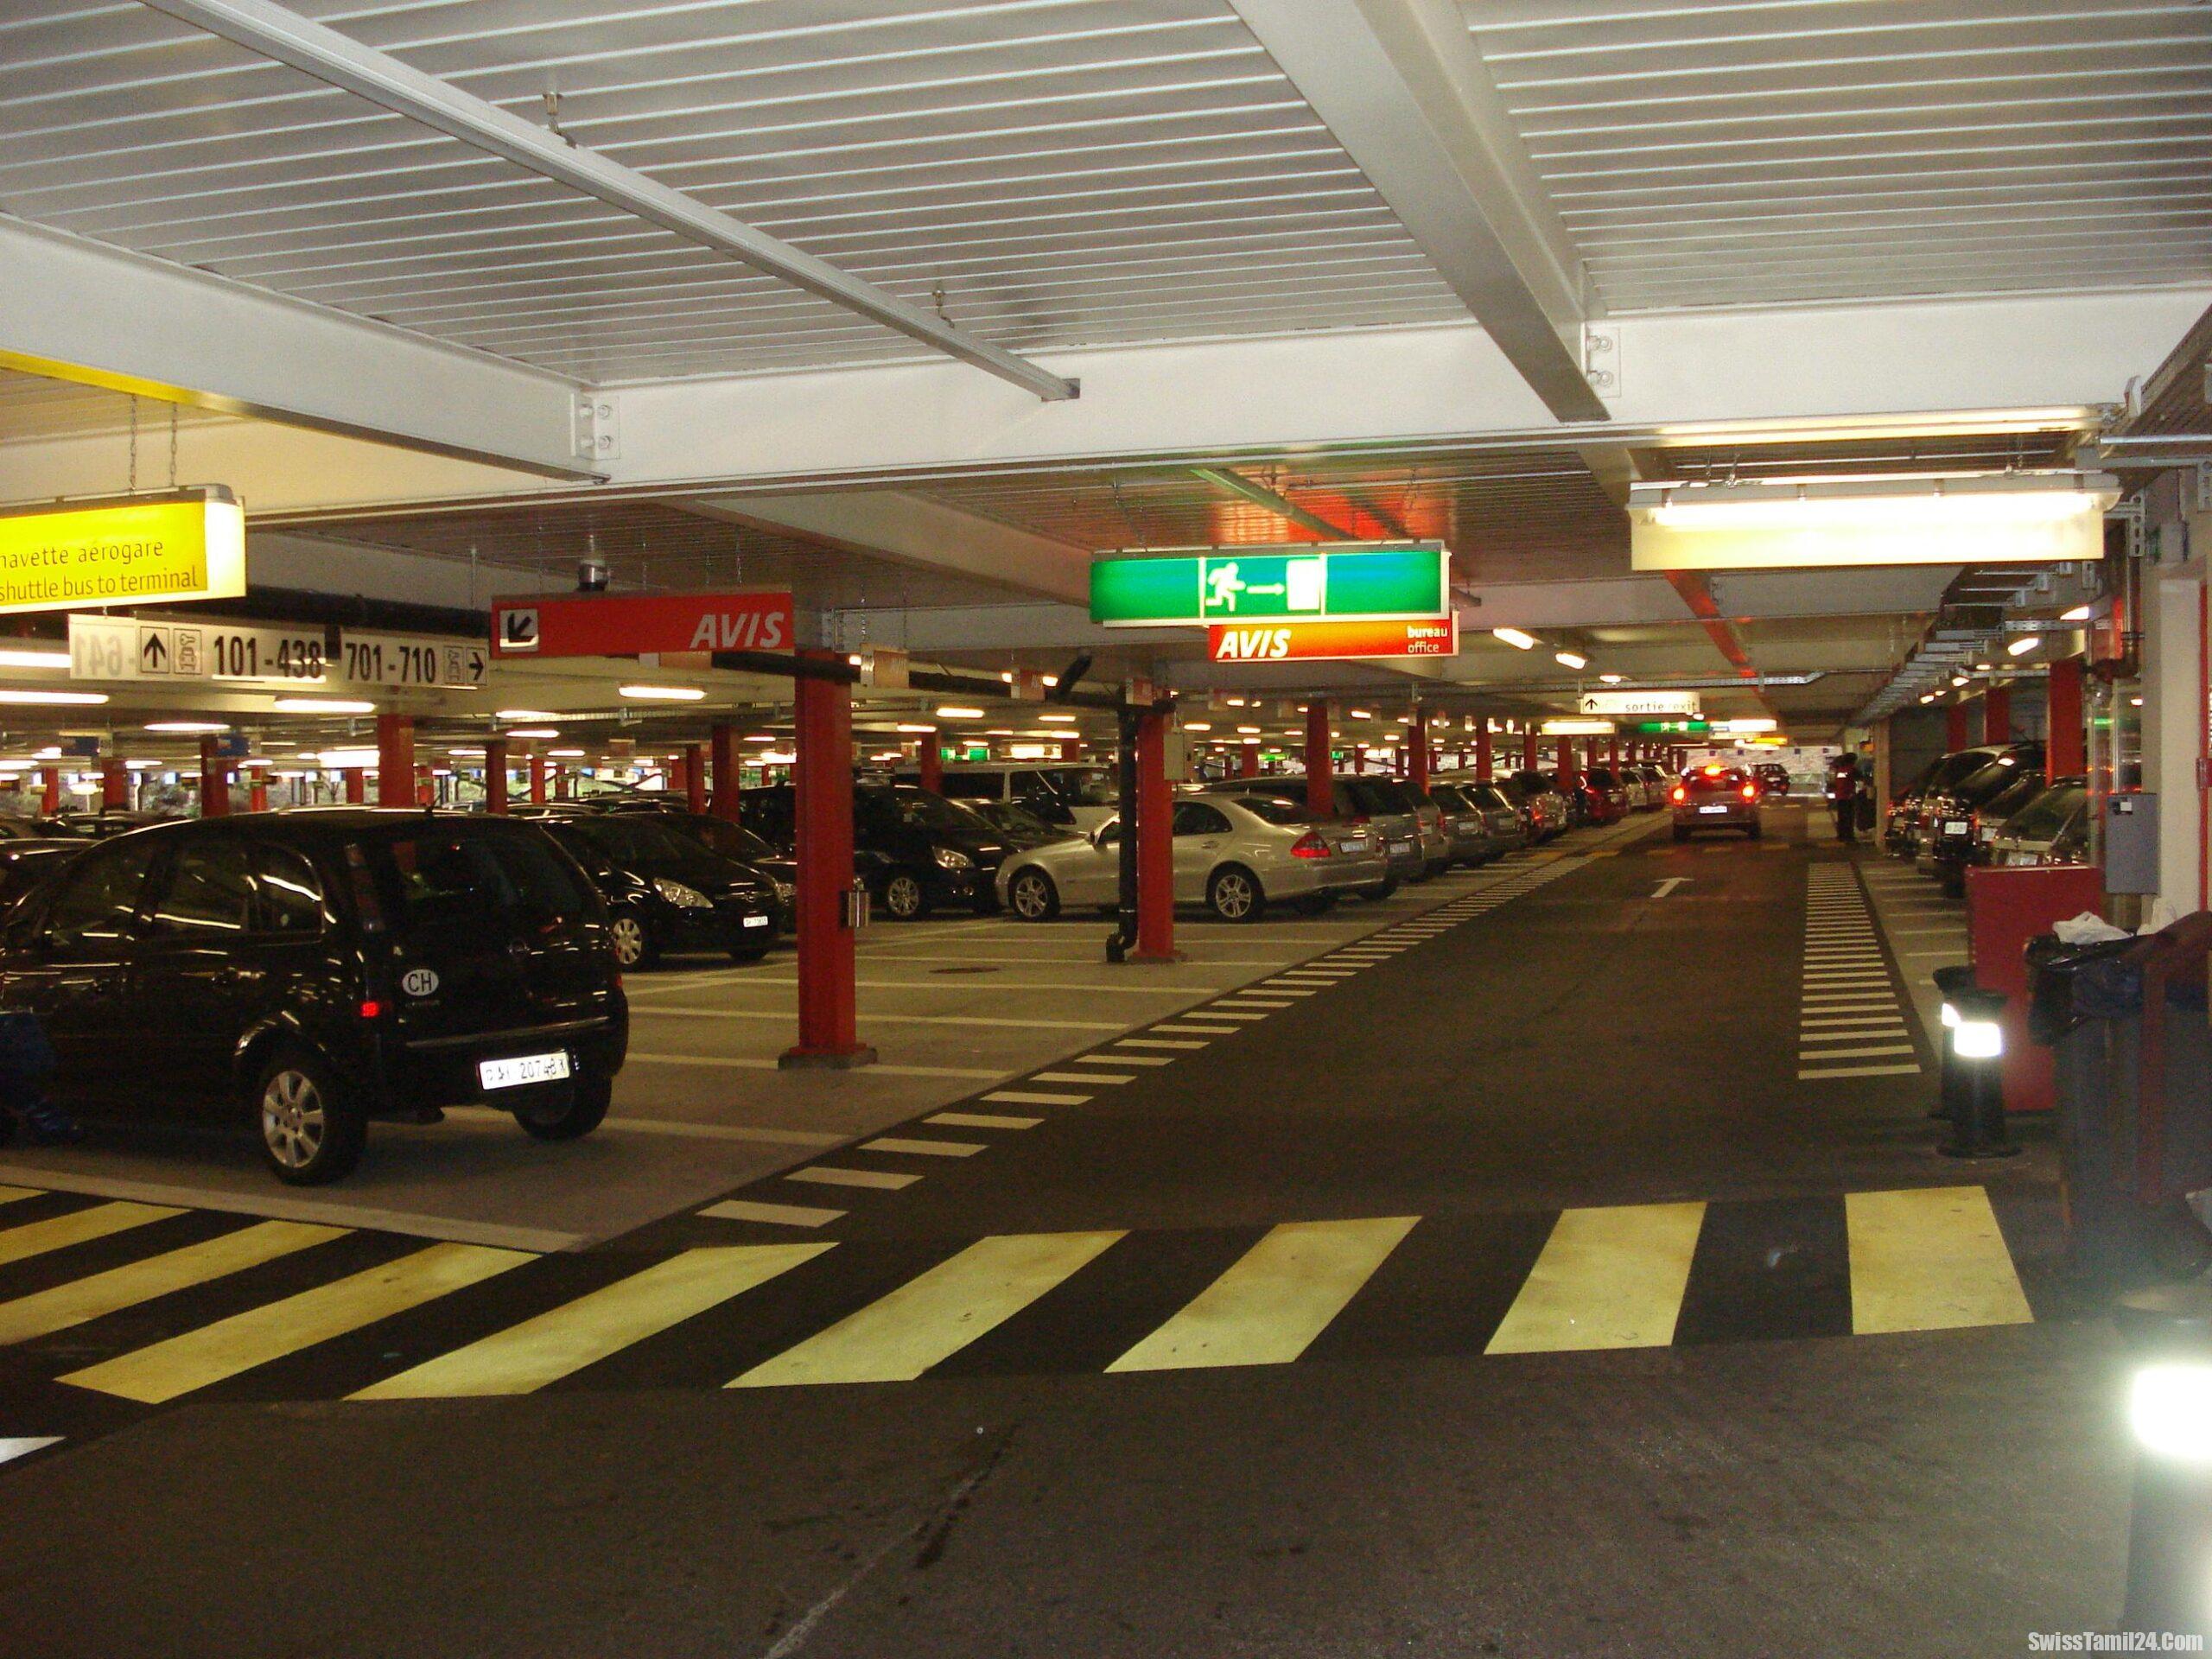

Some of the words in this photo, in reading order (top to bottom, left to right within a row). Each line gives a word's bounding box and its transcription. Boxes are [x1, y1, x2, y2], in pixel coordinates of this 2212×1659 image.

[0, 547, 68, 569] navette
[0, 576, 59, 601] shuttle
[63, 576, 94, 596] bus
[98, 576, 117, 593] to
[121, 565, 199, 591] terminal
[689, 611, 785, 650] AVIS
[1215, 629, 1292, 658] AVIS
[1407, 625, 1449, 639] bureau
[1408, 643, 1440, 654] office
[407, 973, 433, 993] CH
